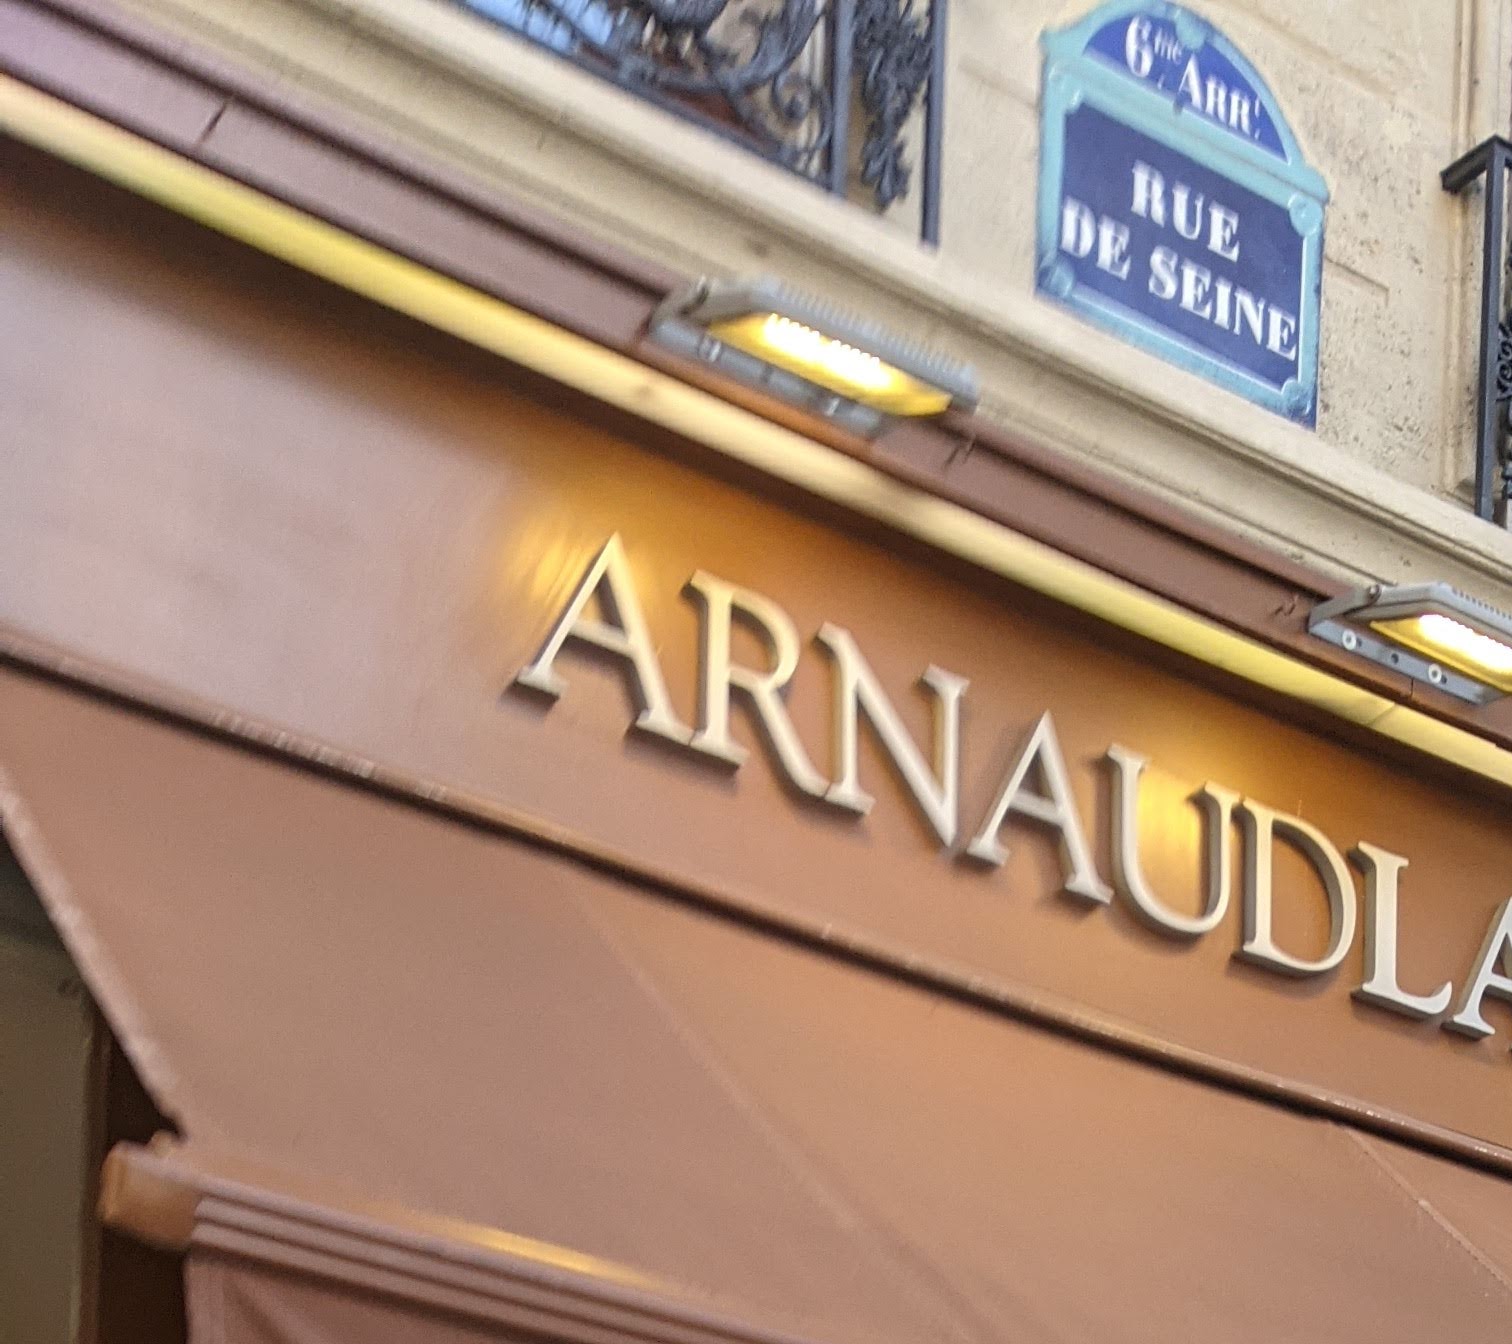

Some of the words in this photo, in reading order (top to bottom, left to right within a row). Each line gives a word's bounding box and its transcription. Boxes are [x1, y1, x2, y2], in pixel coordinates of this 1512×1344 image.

[1131, 160, 1240, 262] RUE
[1060, 196, 1132, 281] DE
[1148, 245, 1297, 361] SEINE
